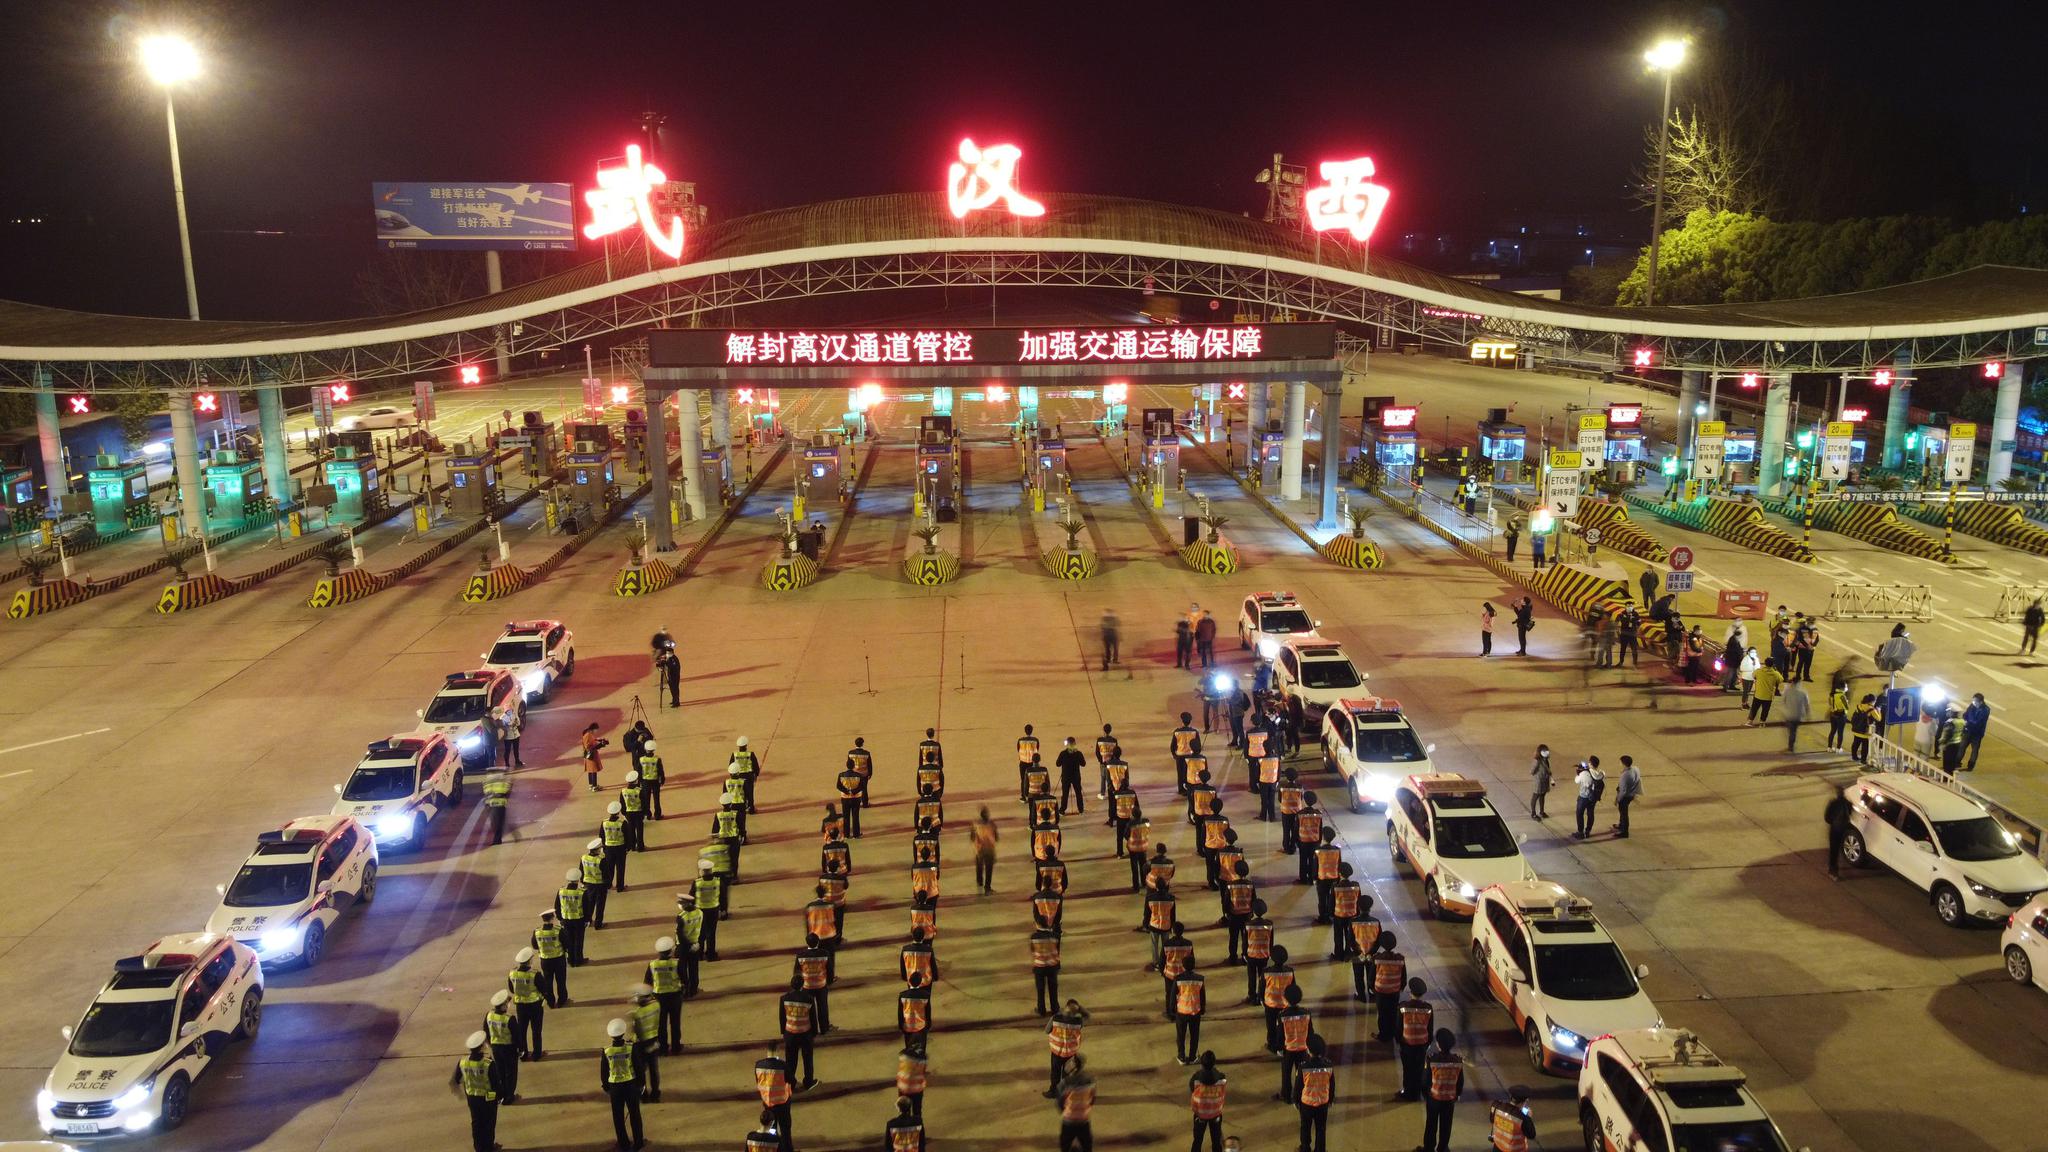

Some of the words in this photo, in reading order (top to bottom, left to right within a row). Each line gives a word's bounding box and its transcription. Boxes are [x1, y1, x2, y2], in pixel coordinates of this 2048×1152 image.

[430, 188, 487, 199] 迎接军运会
[583, 144, 685, 260] 武
[947, 138, 1046, 219] 汉
[1305, 157, 1391, 242] 西
[726, 331, 973, 364] 解封离汉通道管控
[1018, 326, 1262, 362] 加强交通运输保障
[1470, 342, 1517, 359] ETC
[1584, 418, 1593, 428] 20
[1831, 425, 1840, 434] 20
[1955, 426, 1961, 435] 5
[1554, 454, 1566, 465] 20
[1551, 476, 1577, 485] ETC专用
[1674, 551, 1689, 566] 停
[231, 915, 268, 926] 警察
[220, 991, 236, 1015] 公安
[75, 1068, 118, 1081] 警察
[66, 1081, 110, 1090] POLICE
